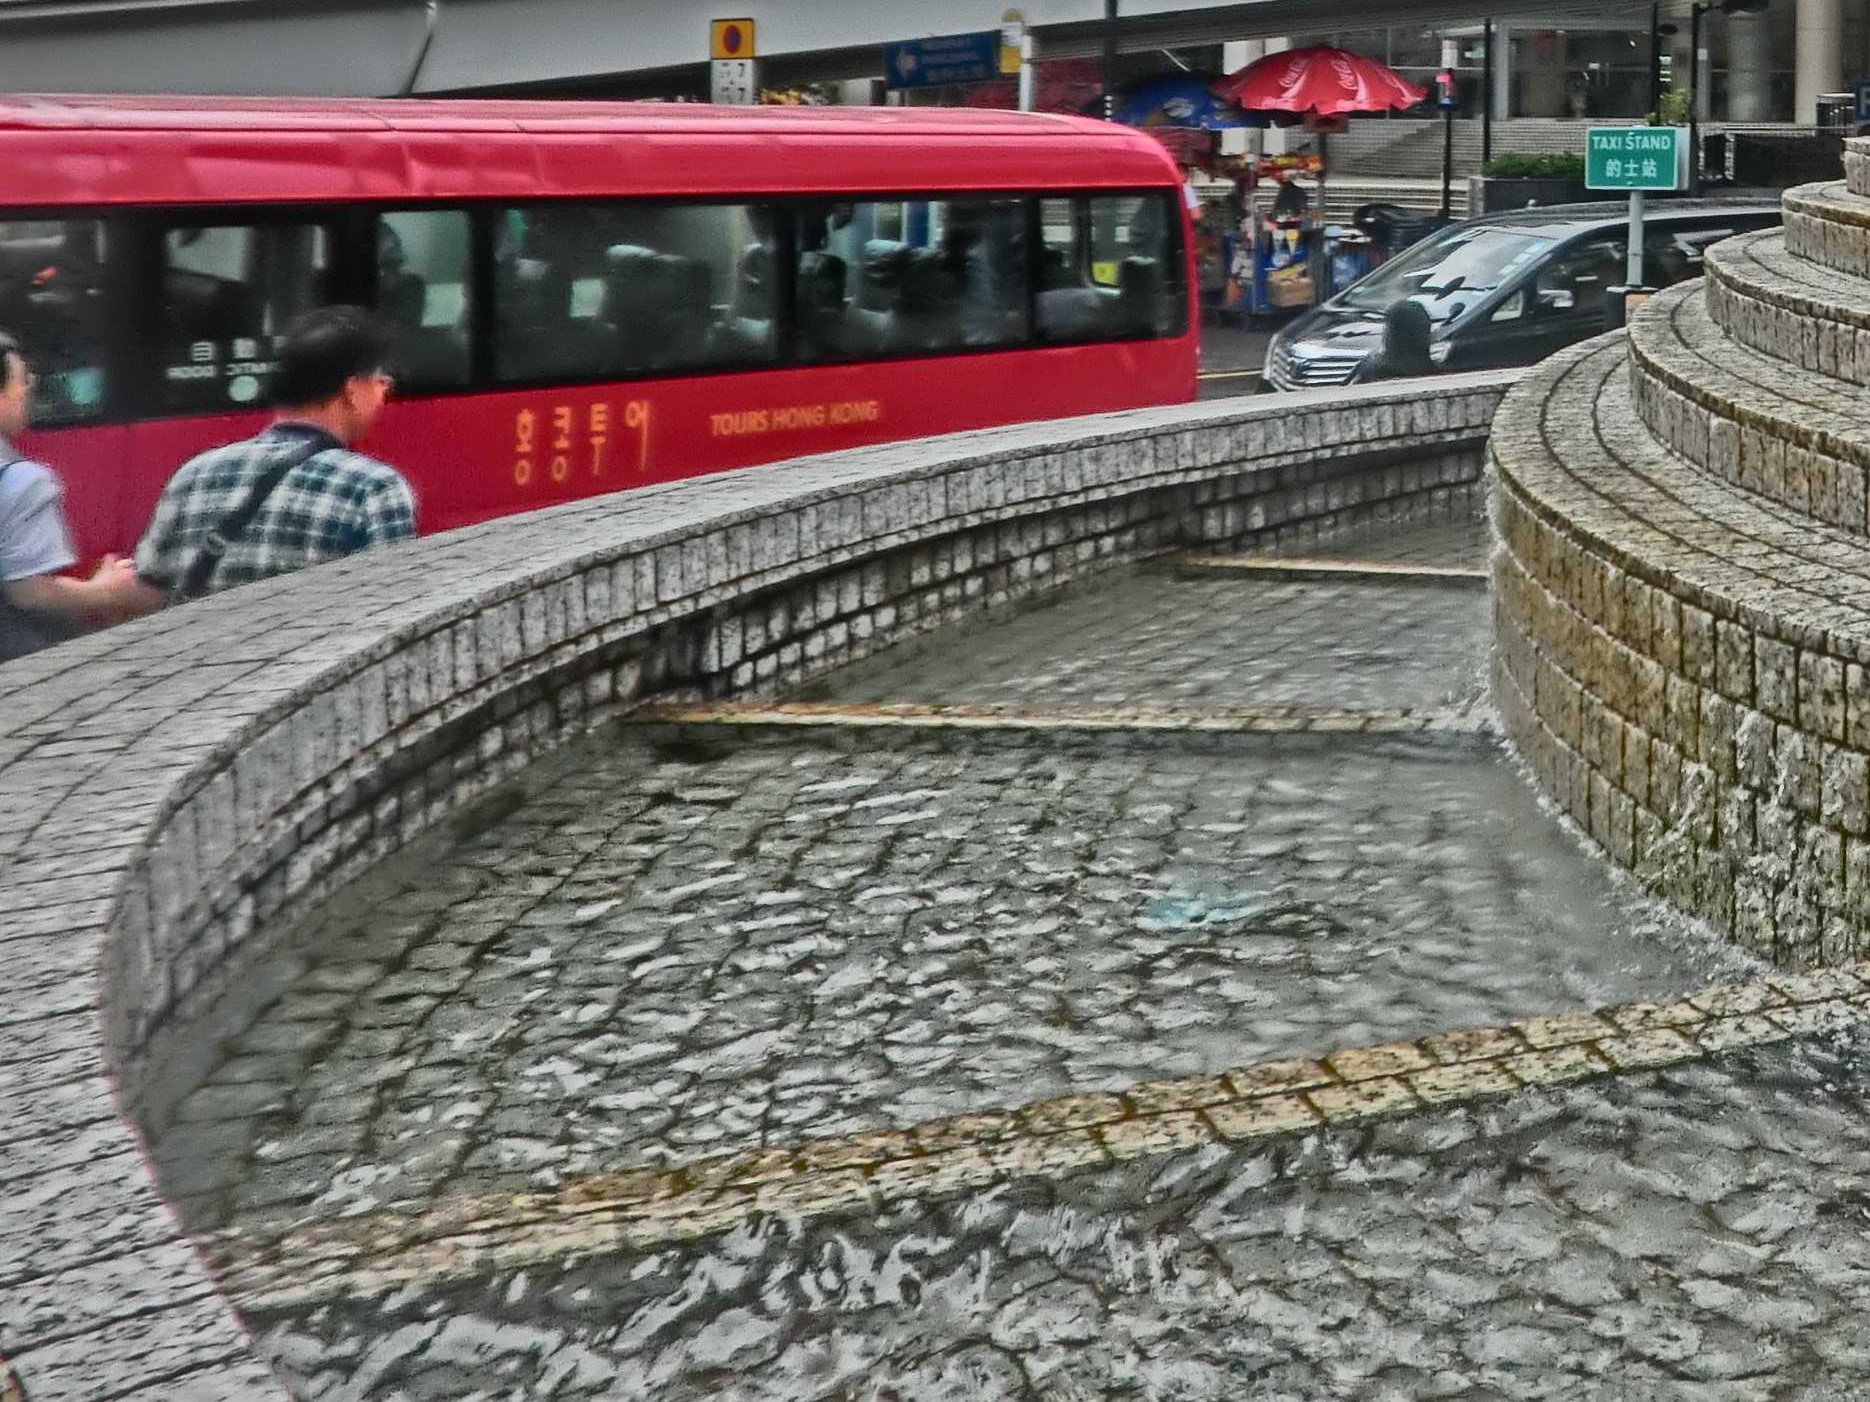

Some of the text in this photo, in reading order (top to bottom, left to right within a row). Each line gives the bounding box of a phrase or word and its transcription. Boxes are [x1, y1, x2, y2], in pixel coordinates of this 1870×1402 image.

[1592, 135, 1671, 150] TAXI STAND
[1605, 158, 1657, 178] 的士站
[710, 400, 880, 436] TOURS HONG KONG
[514, 398, 650, 487] 홍콩투어
